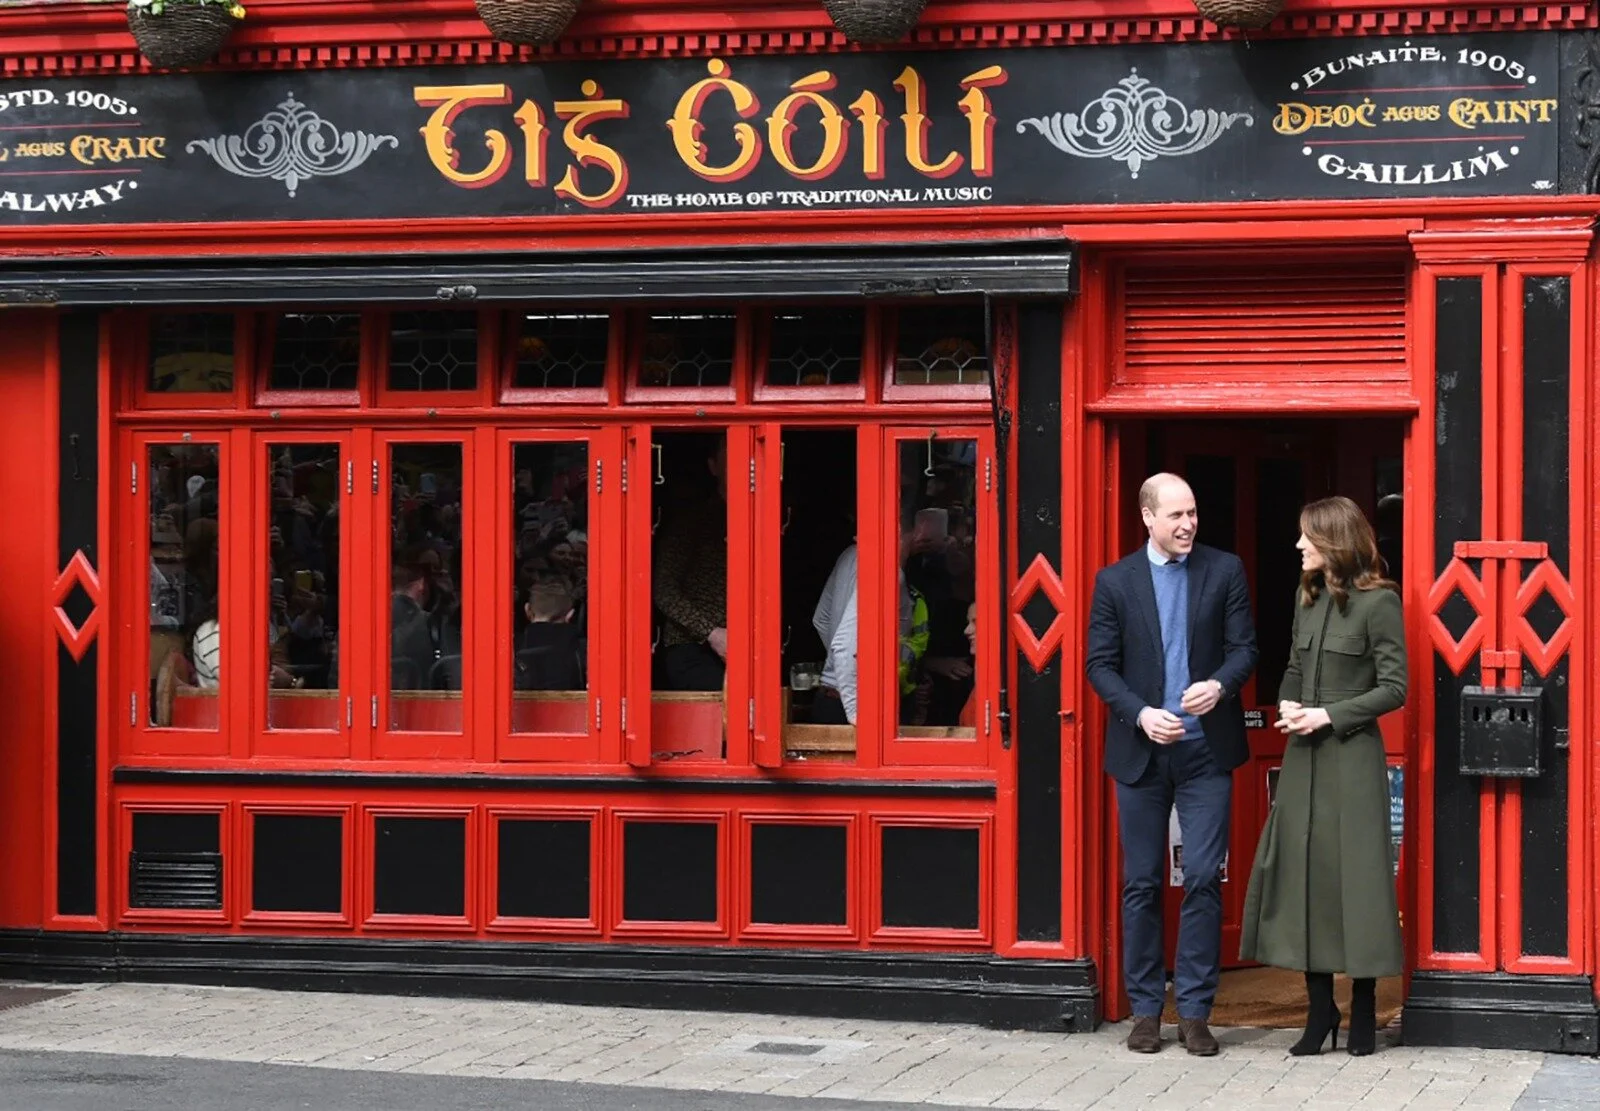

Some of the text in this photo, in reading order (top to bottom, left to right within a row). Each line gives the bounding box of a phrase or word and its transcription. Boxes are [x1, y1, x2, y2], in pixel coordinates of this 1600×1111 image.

[1458, 49, 1525, 79] 1905
[0, 89, 59, 112] STD.
[1382, 105, 1441, 122] AGUS
[1447, 98, 1558, 129] CAINT
[14, 142, 66, 157] AGUS
[70, 135, 165, 165] CRAIC
[0, 180, 125, 212] ALWAY
[627, 186, 992, 207] THE HOME OF TRADITIONAL MUSIC
